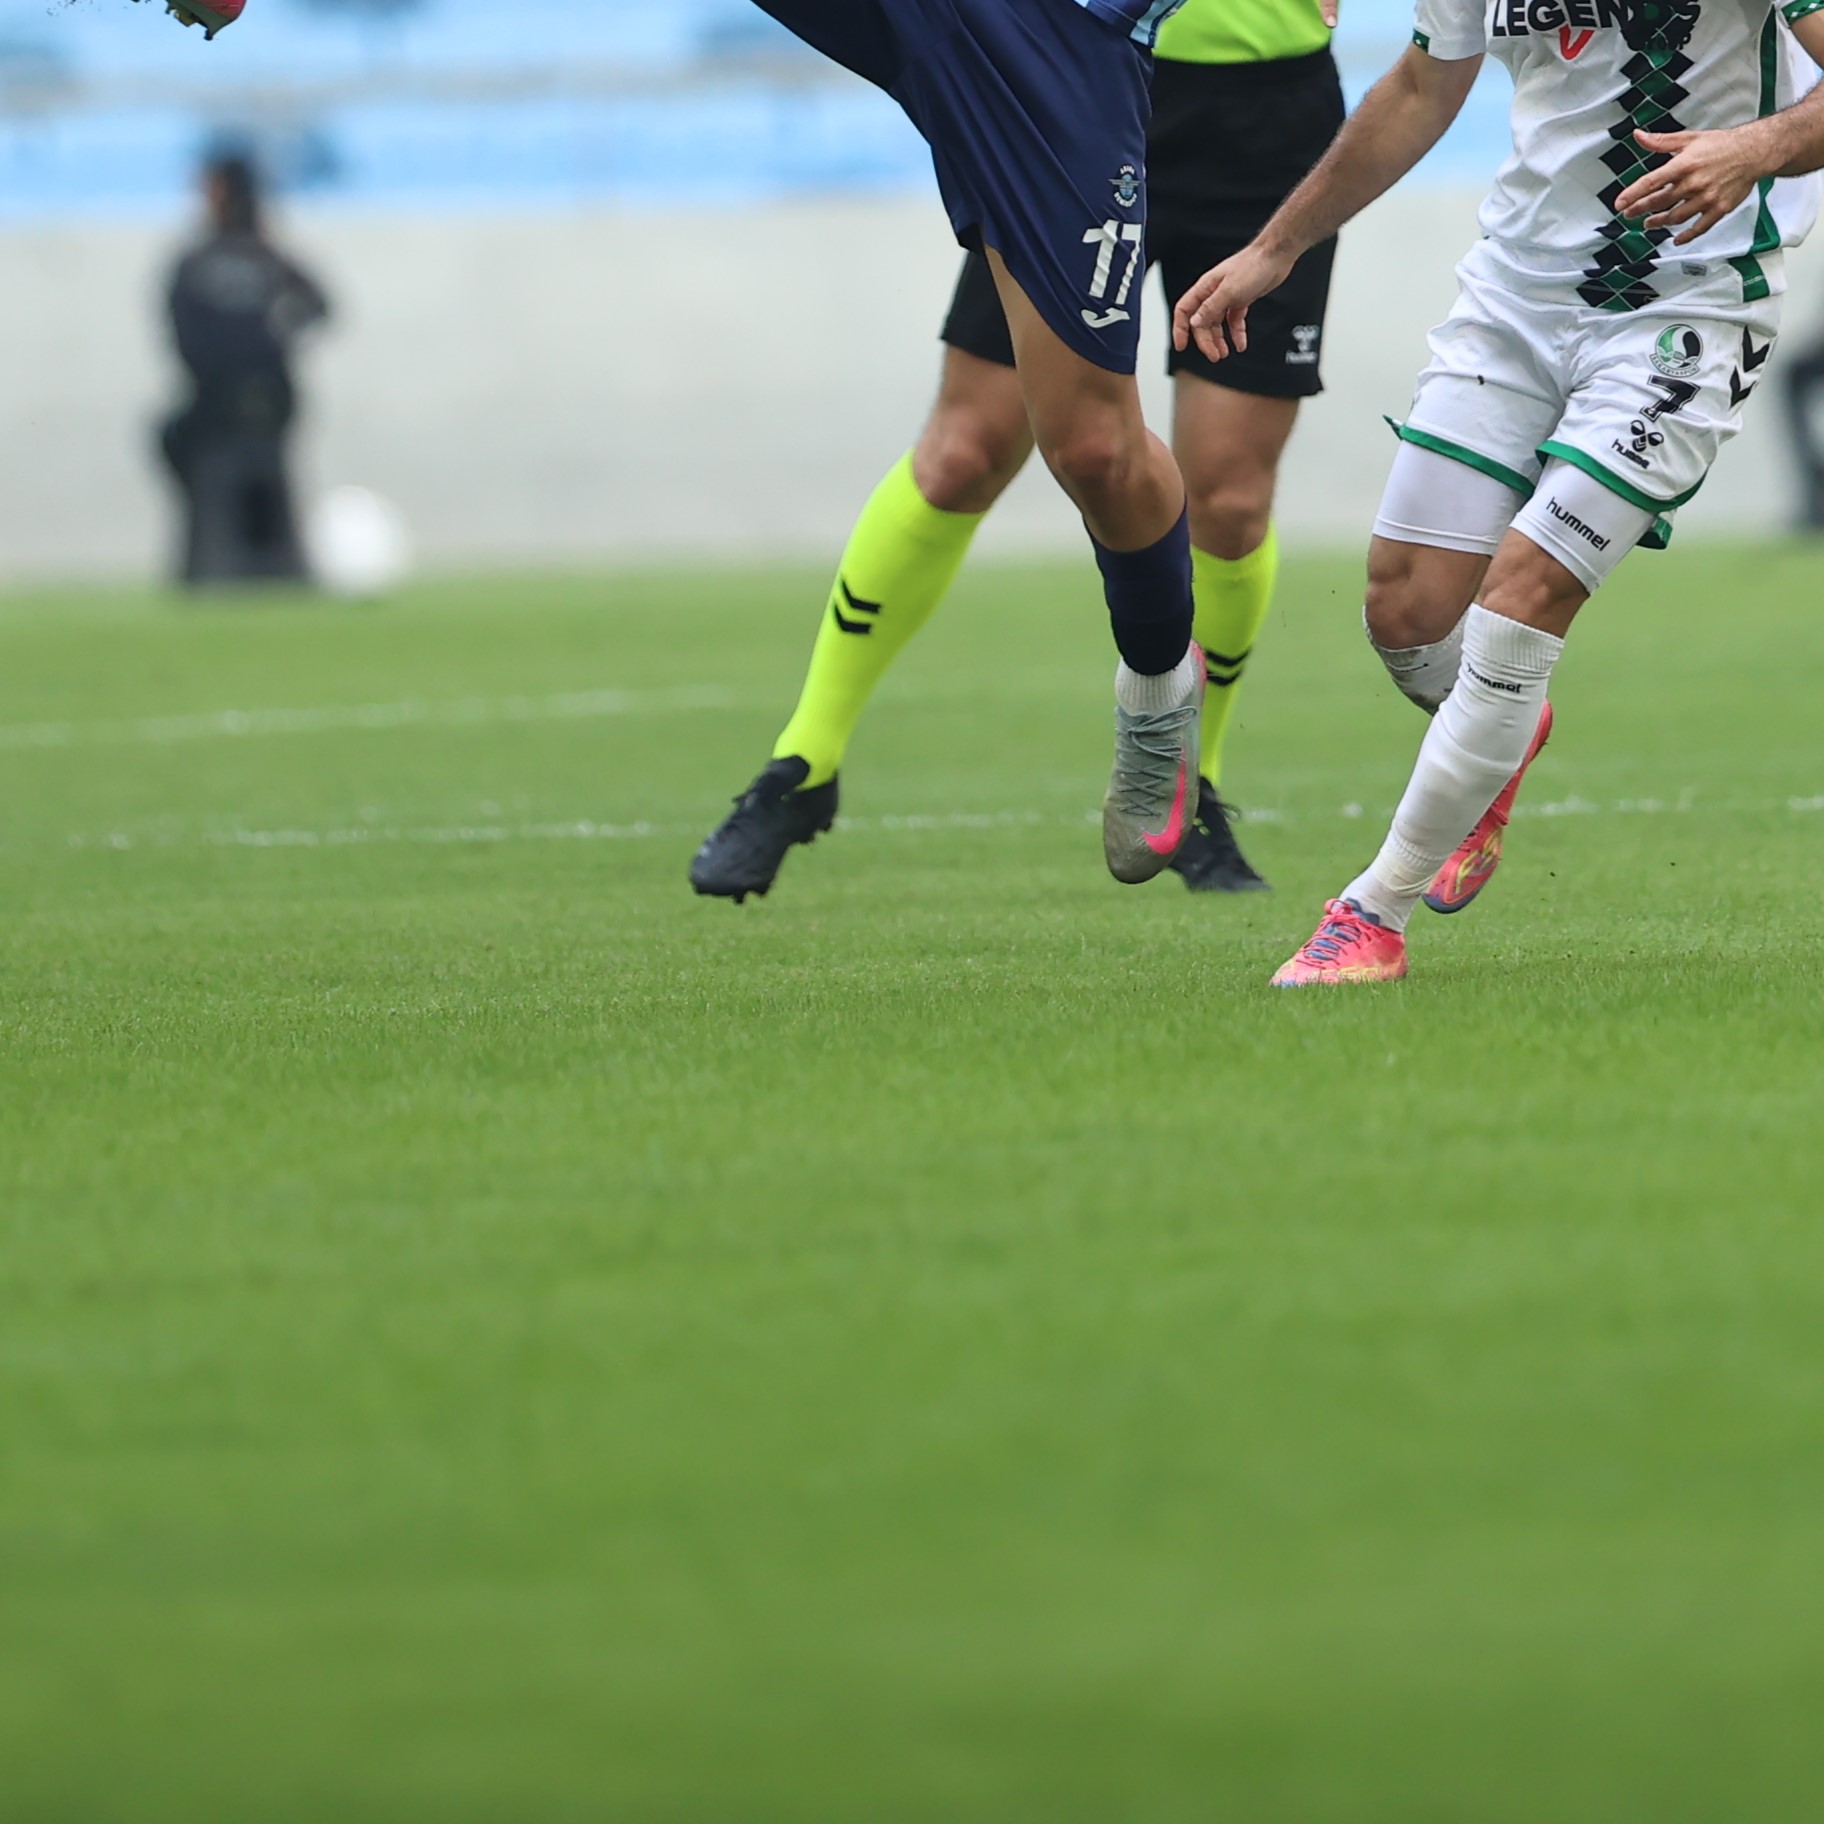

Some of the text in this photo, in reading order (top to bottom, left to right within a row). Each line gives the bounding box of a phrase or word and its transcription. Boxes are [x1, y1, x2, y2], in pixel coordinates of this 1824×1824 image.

[1082, 219, 1142, 305] 17
[1639, 374, 1702, 423] 7
[1546, 496, 1612, 553] hummel
